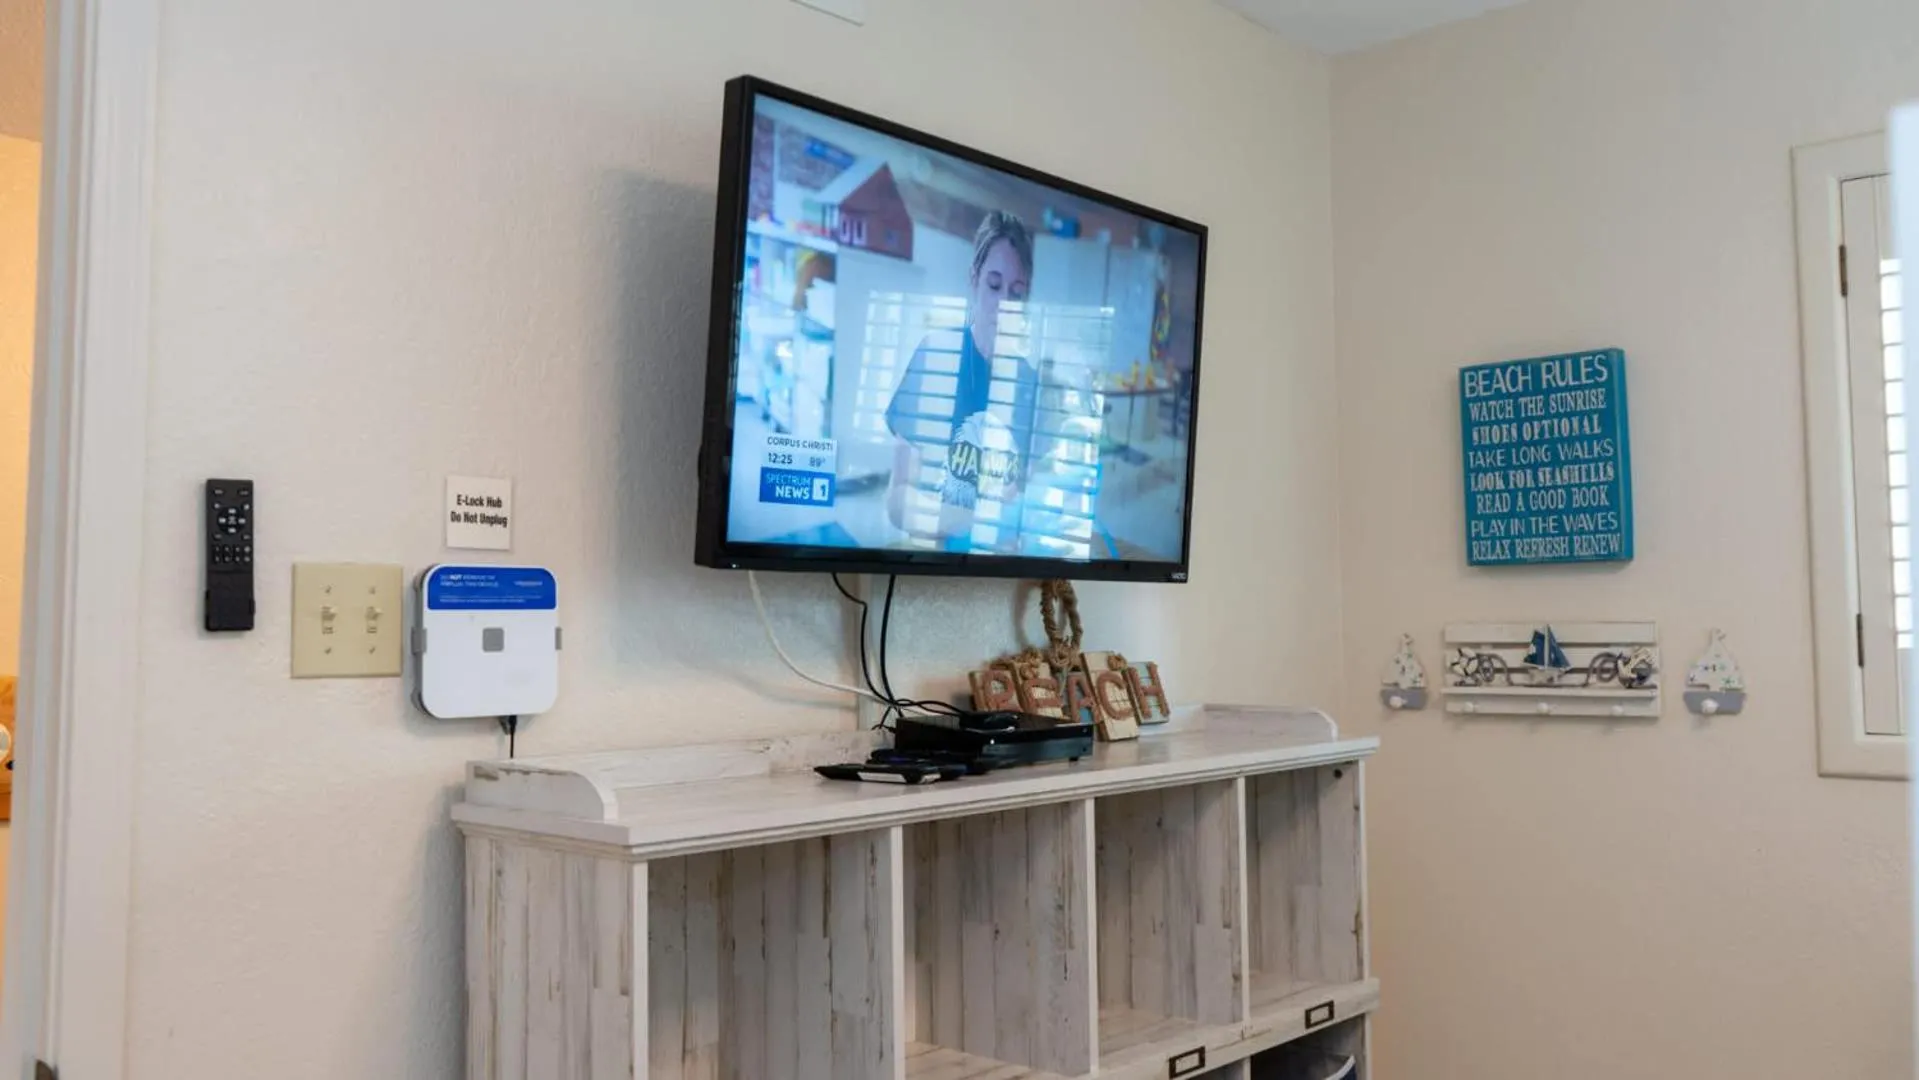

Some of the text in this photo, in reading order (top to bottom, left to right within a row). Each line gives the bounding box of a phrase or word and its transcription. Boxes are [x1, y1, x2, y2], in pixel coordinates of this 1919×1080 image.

[1464, 354, 1608, 398] BEACH RULES
[1469, 388, 1606, 422] WATCH THE SUNRISE
[767, 436, 833, 451] CORPUS CHRISTI
[1472, 414, 1602, 446] SHOES OPTIONAL
[768, 452, 793, 465] 12:25
[1468, 438, 1614, 469] TAKE LONG WALKS
[766, 473, 811, 485] SPECTRUM
[1470, 461, 1614, 492] LOOK FOR SEASHELLS
[456, 494, 502, 508] E-Lock Hub
[775, 485, 810, 499] NEWS
[1476, 485, 1610, 515] READ A GOOD BOOK
[450, 510, 508, 528] Do Not Unplug
[1471, 511, 1618, 538] PLAY IN THE WAVES
[1472, 533, 1621, 561] RELAX REFRESH RENEW
